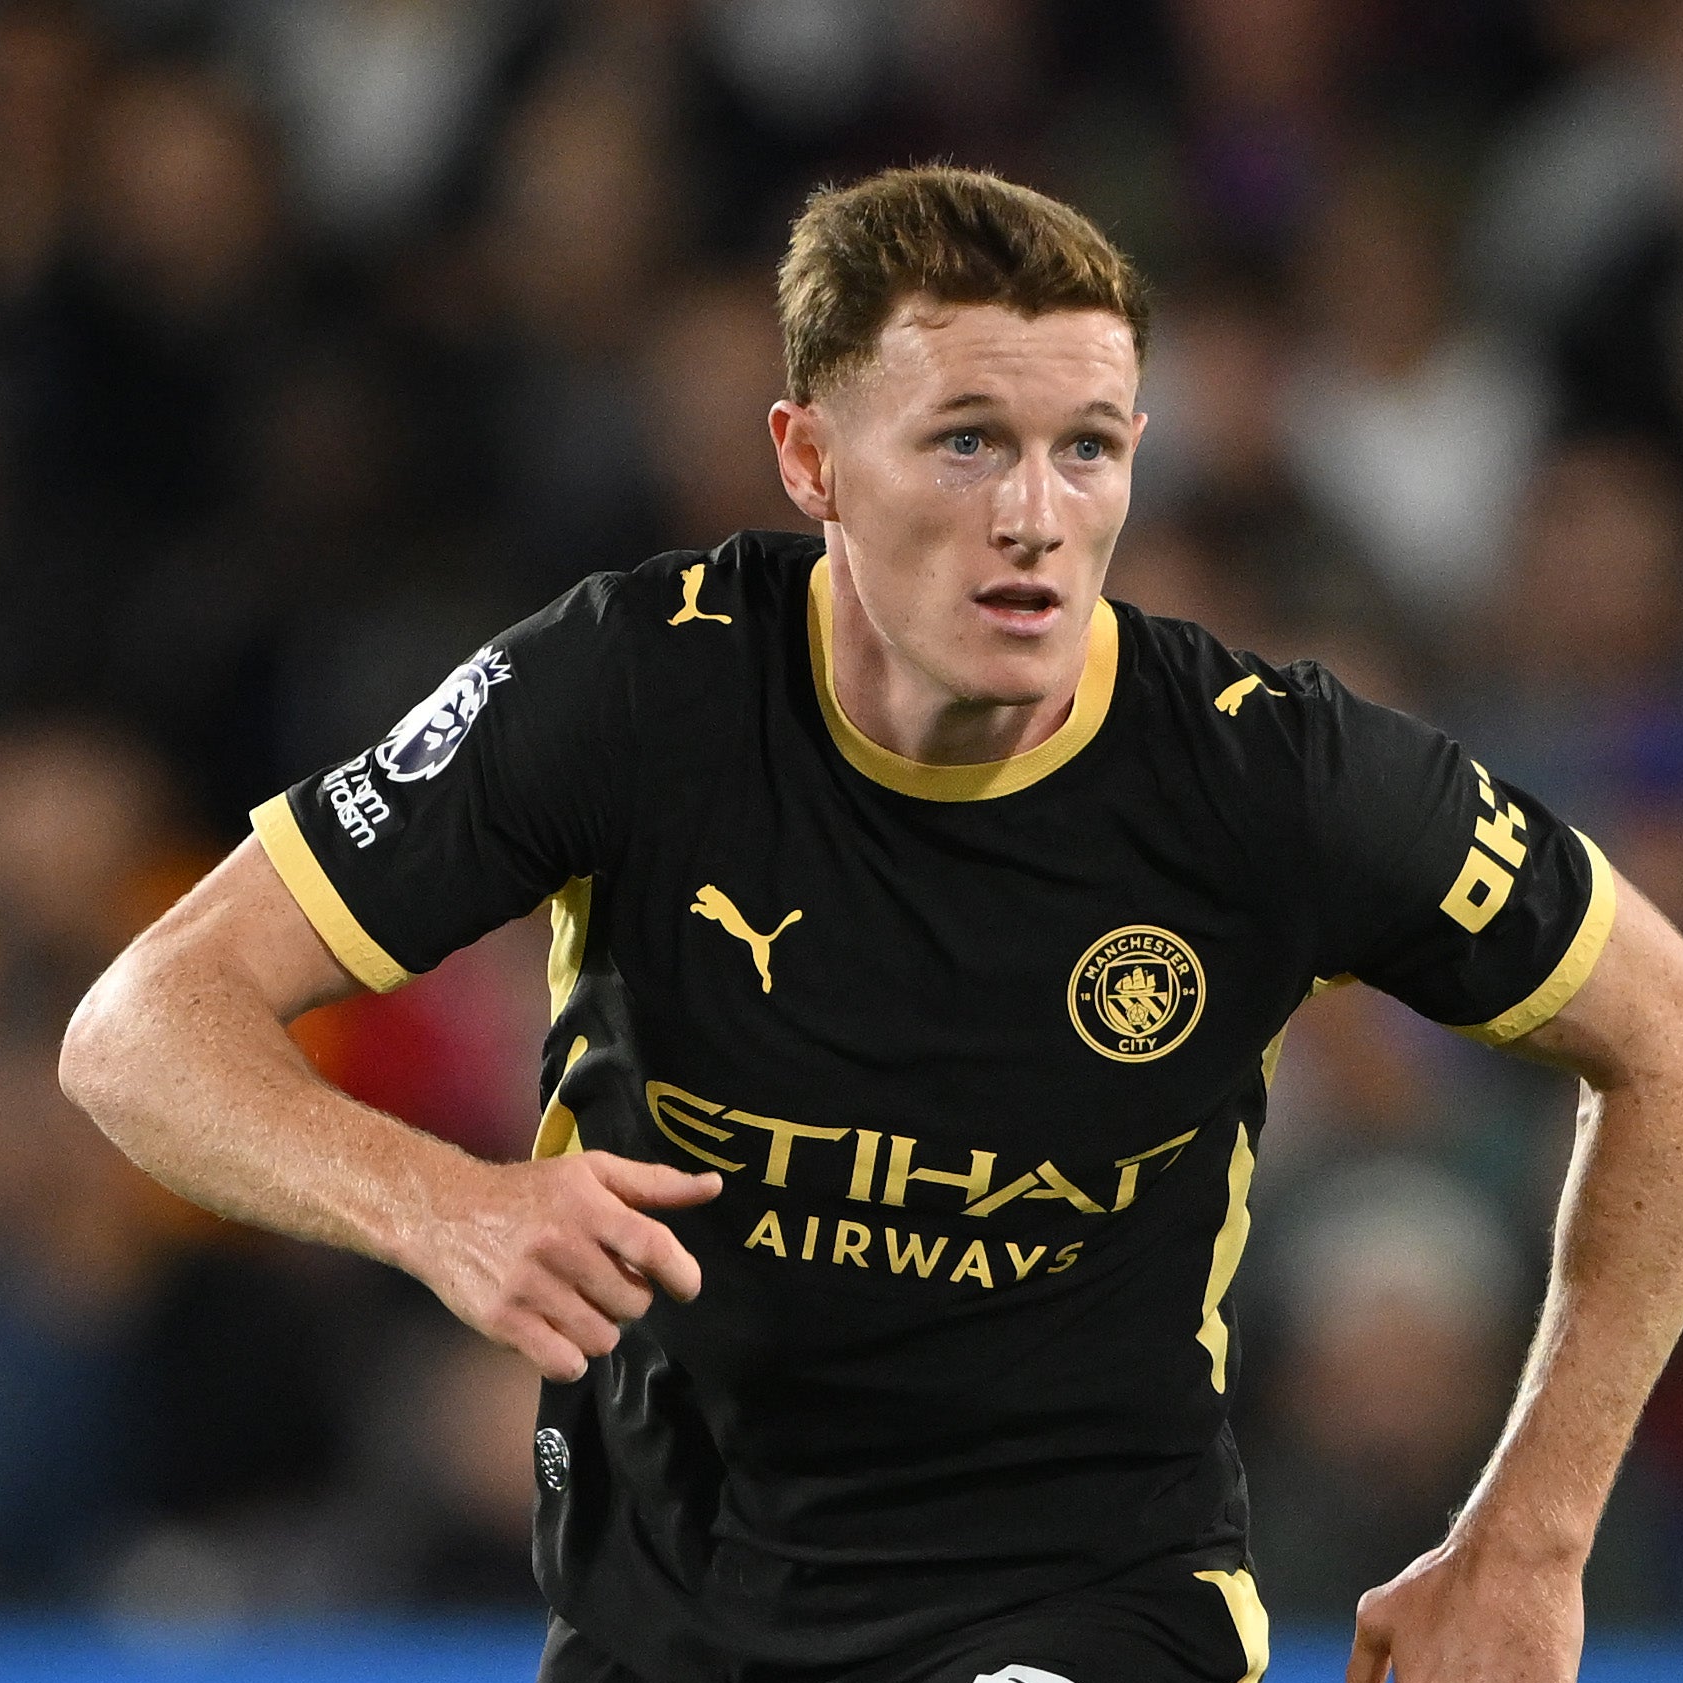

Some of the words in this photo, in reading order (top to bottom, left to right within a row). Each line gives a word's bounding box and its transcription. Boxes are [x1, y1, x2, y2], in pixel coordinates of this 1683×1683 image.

[1439, 760, 1527, 934] OK
[1084, 936, 1190, 980] MANCHESTER
[1182, 987, 1196, 996] 94
[1118, 1038, 1157, 1052] CITY
[743, 1210, 1084, 1289] AIRWAYS
